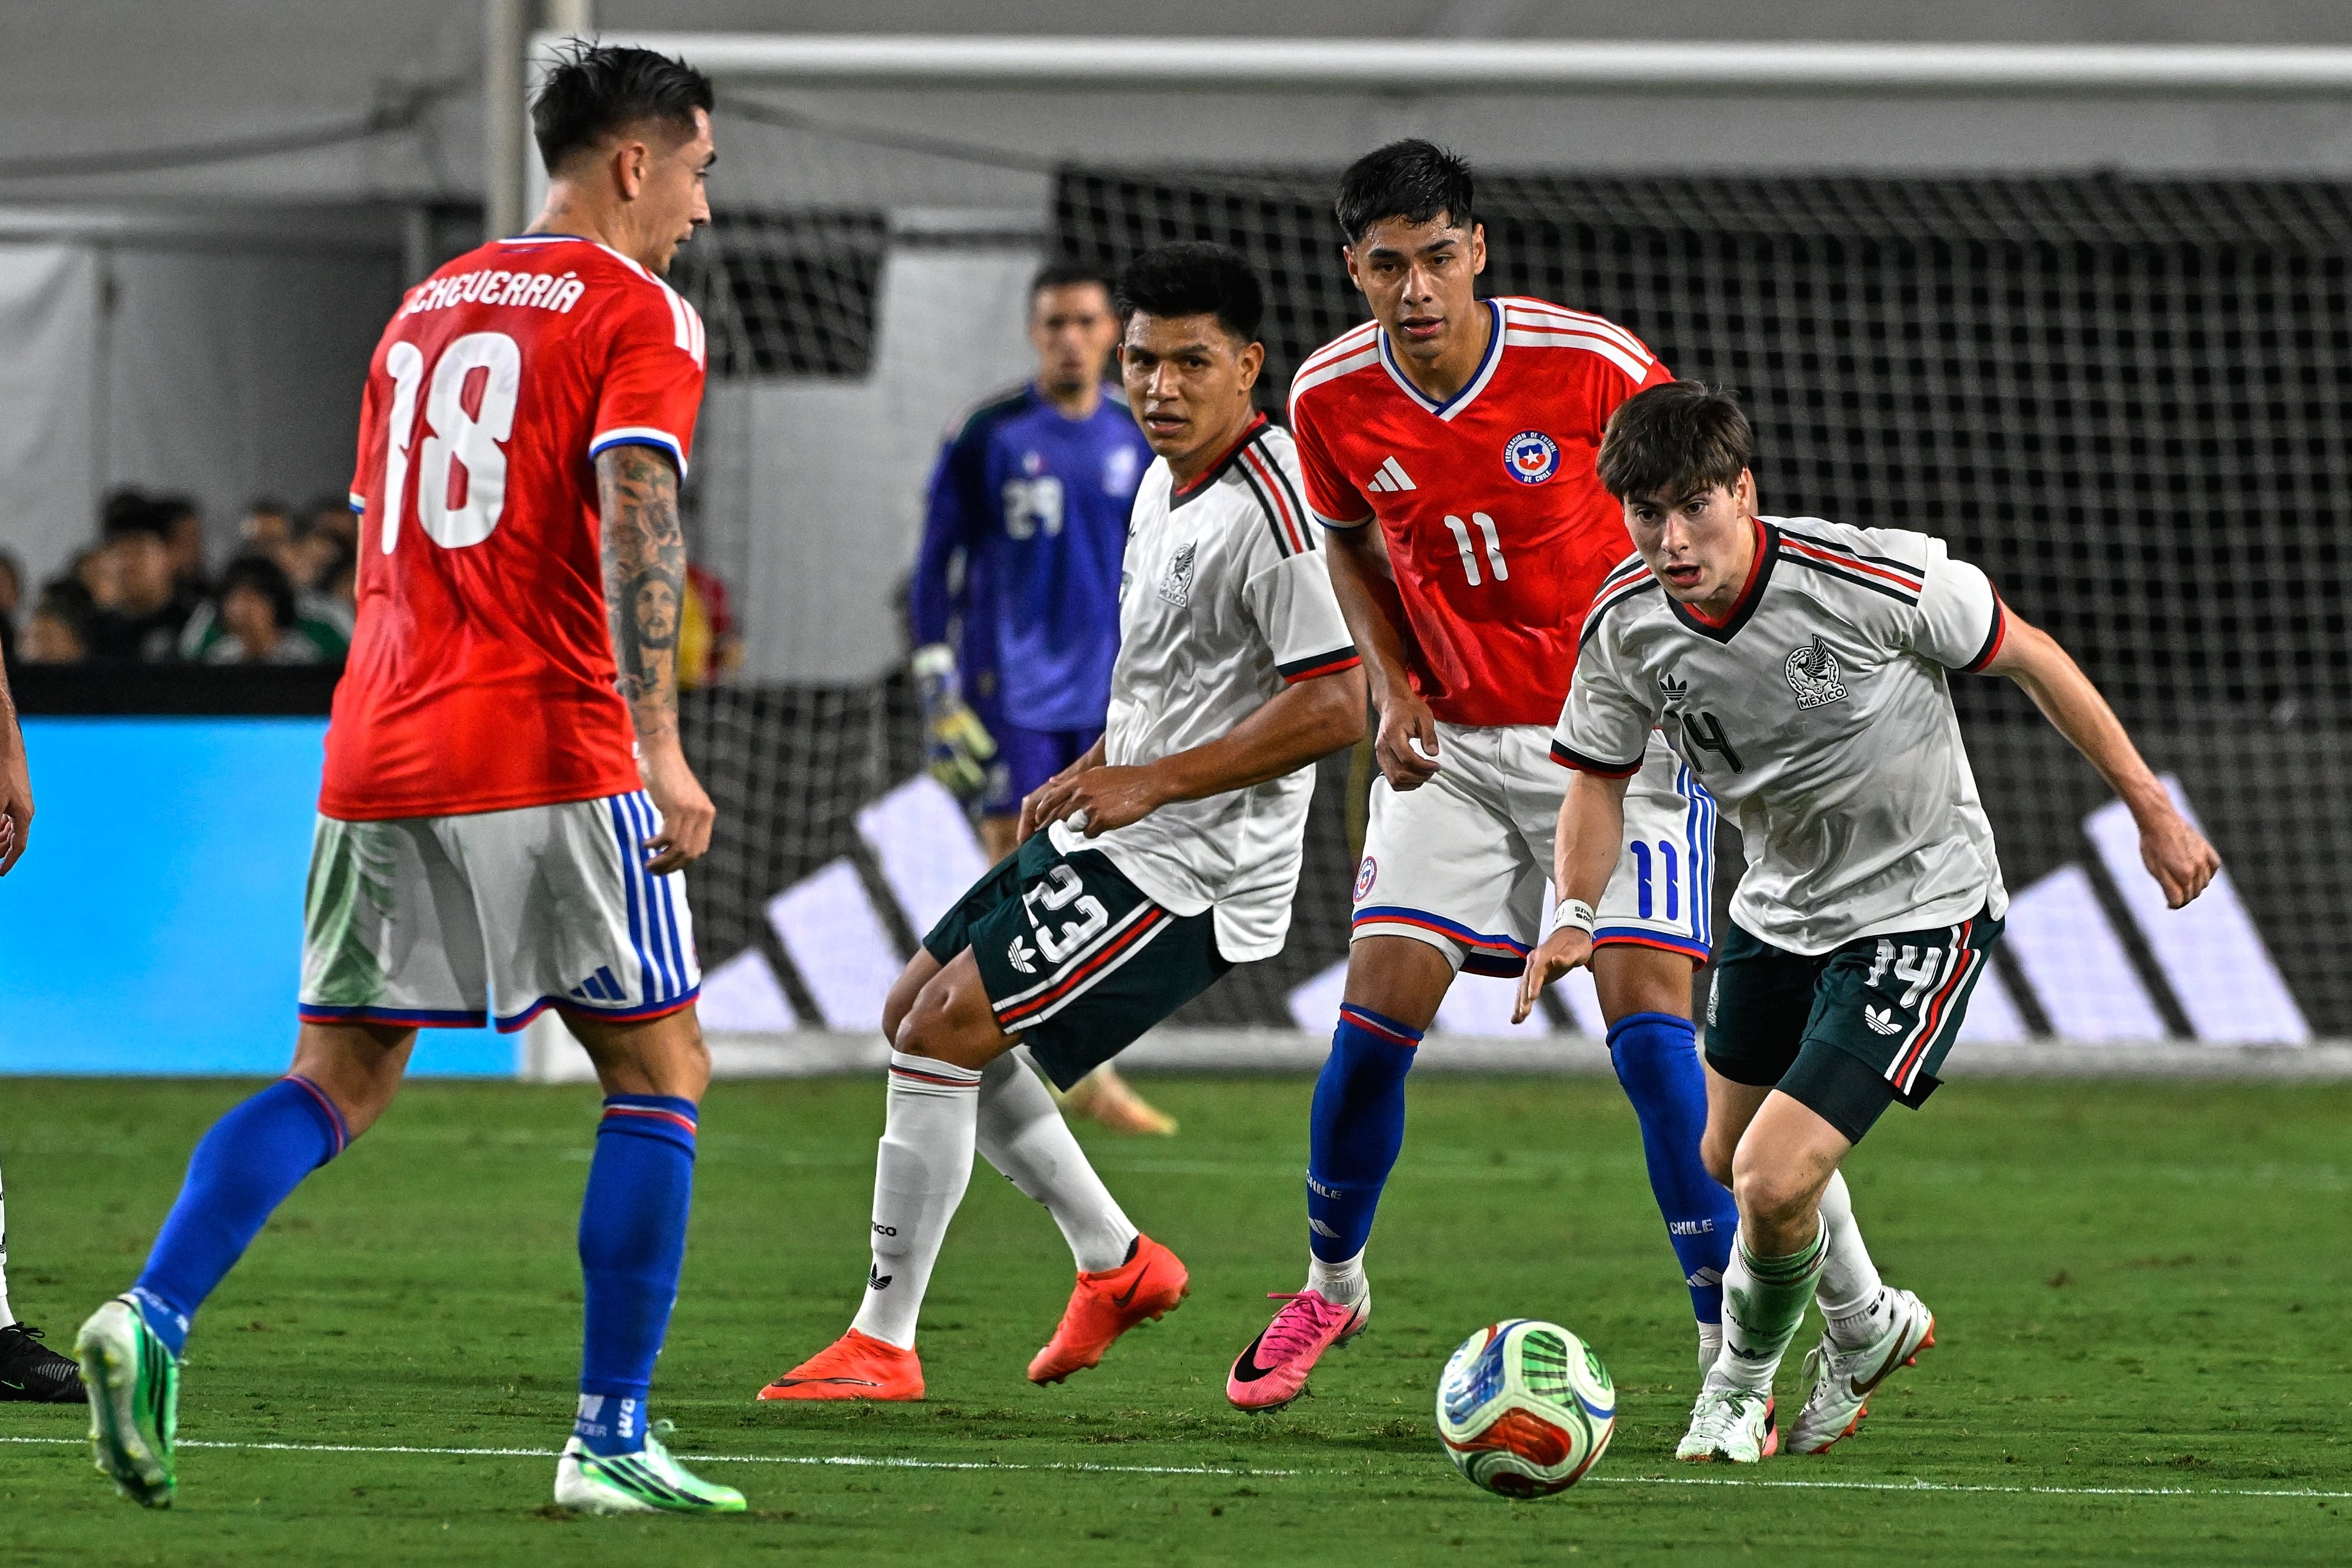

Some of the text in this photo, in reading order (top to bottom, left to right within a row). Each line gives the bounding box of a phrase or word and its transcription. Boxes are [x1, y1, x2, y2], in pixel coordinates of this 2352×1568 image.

[382, 332, 521, 554] 18
[1505, 433, 1526, 463] FEDERACION
[1541, 435, 1558, 453] FUTBOL
[1535, 470, 1552, 482] CHILE
[1444, 512, 1508, 586] 11
[1799, 688, 1845, 708] MÉXICO
[1663, 710, 1745, 774] 14
[1631, 840, 1678, 921] 11
[1022, 864, 1108, 964] 23
[1864, 939, 1942, 1008] 14
[1306, 1169, 1342, 1200] CHILE
[1669, 1218, 1715, 1235] CHILE
